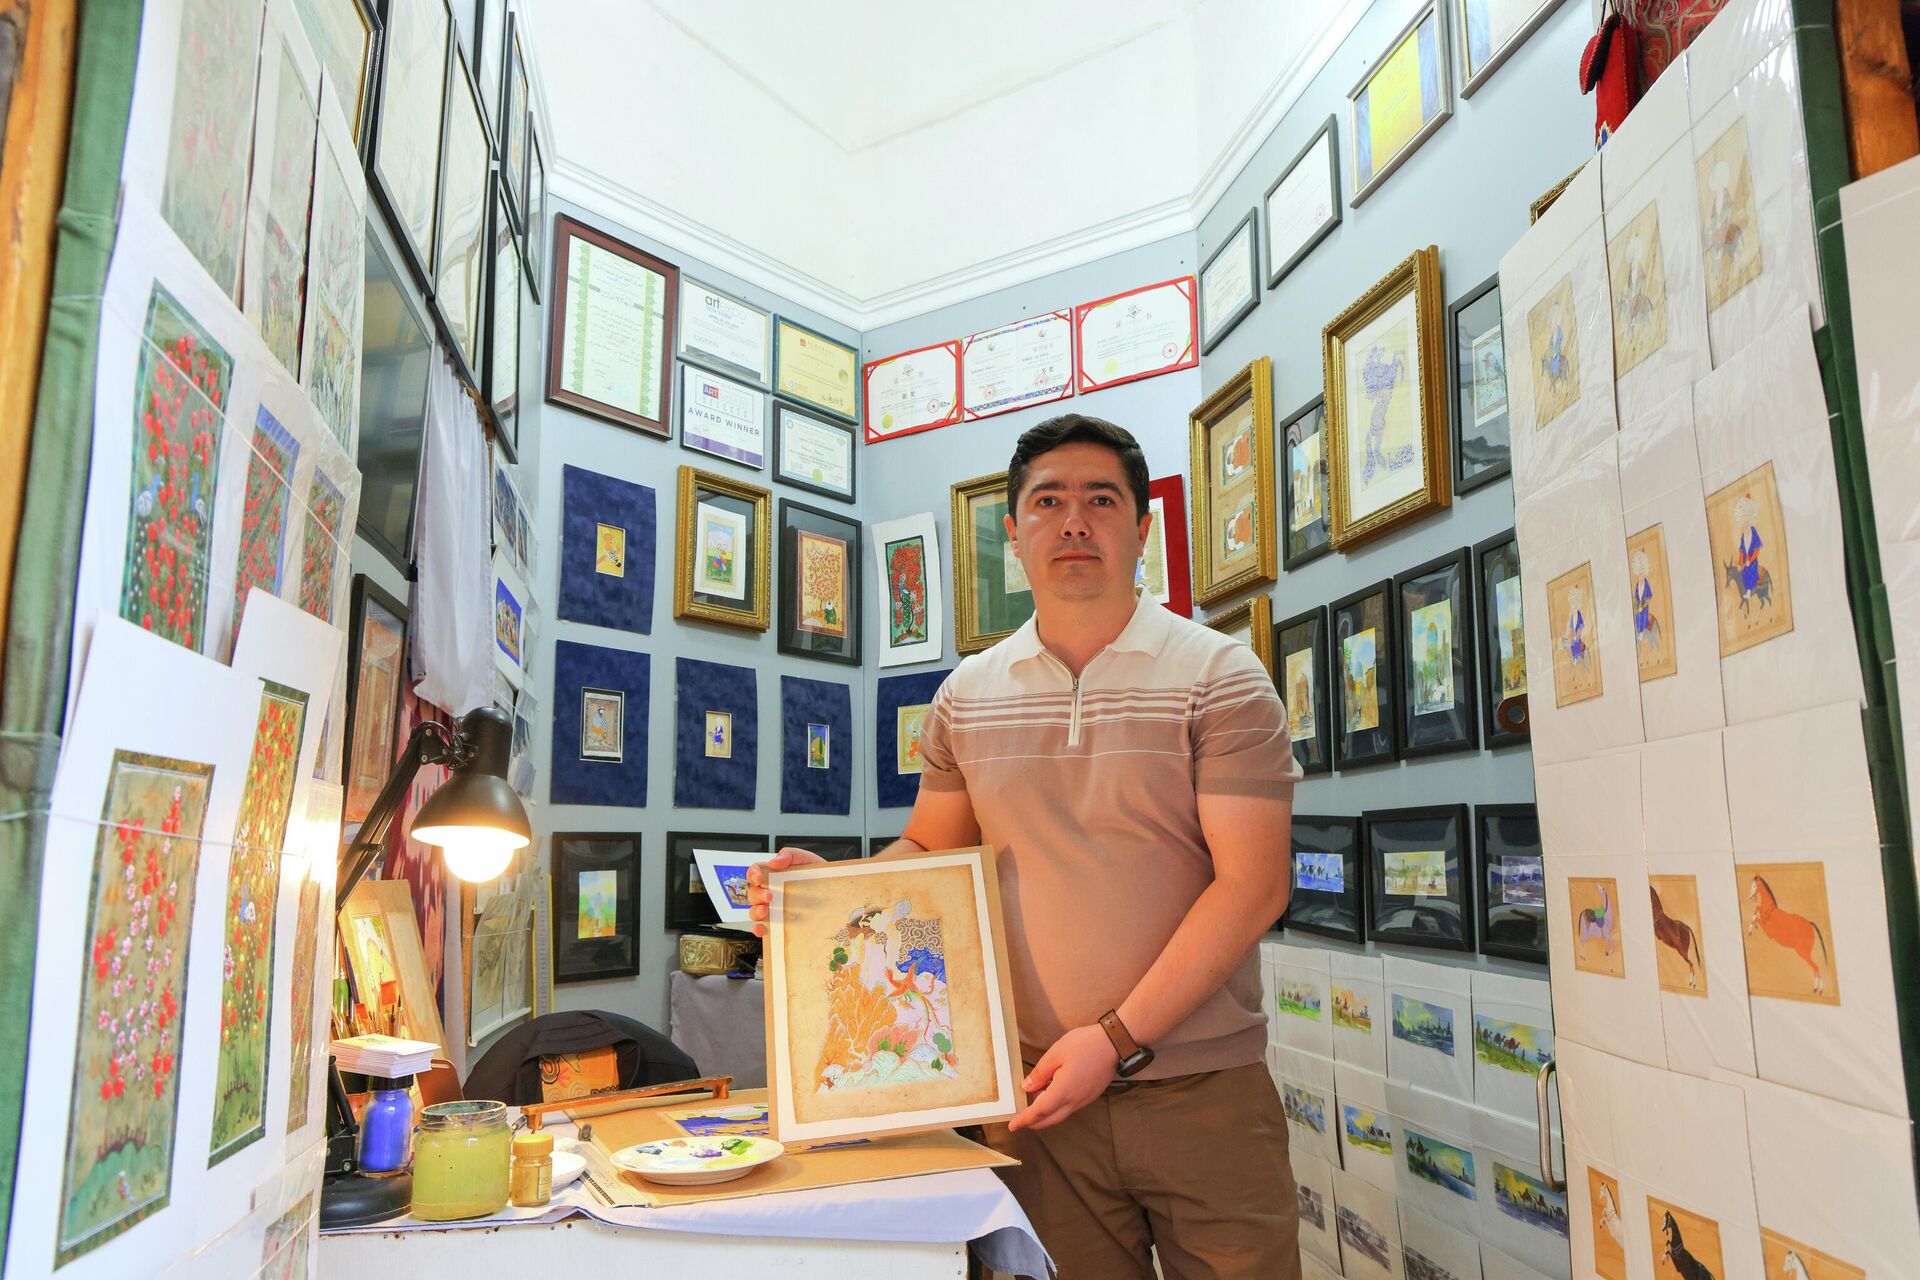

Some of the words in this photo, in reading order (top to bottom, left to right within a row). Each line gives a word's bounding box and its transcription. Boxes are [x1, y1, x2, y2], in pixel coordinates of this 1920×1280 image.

[704, 386, 719, 398] ART
[688, 407, 722, 424] AWARD
[726, 420, 760, 436] WINNER
